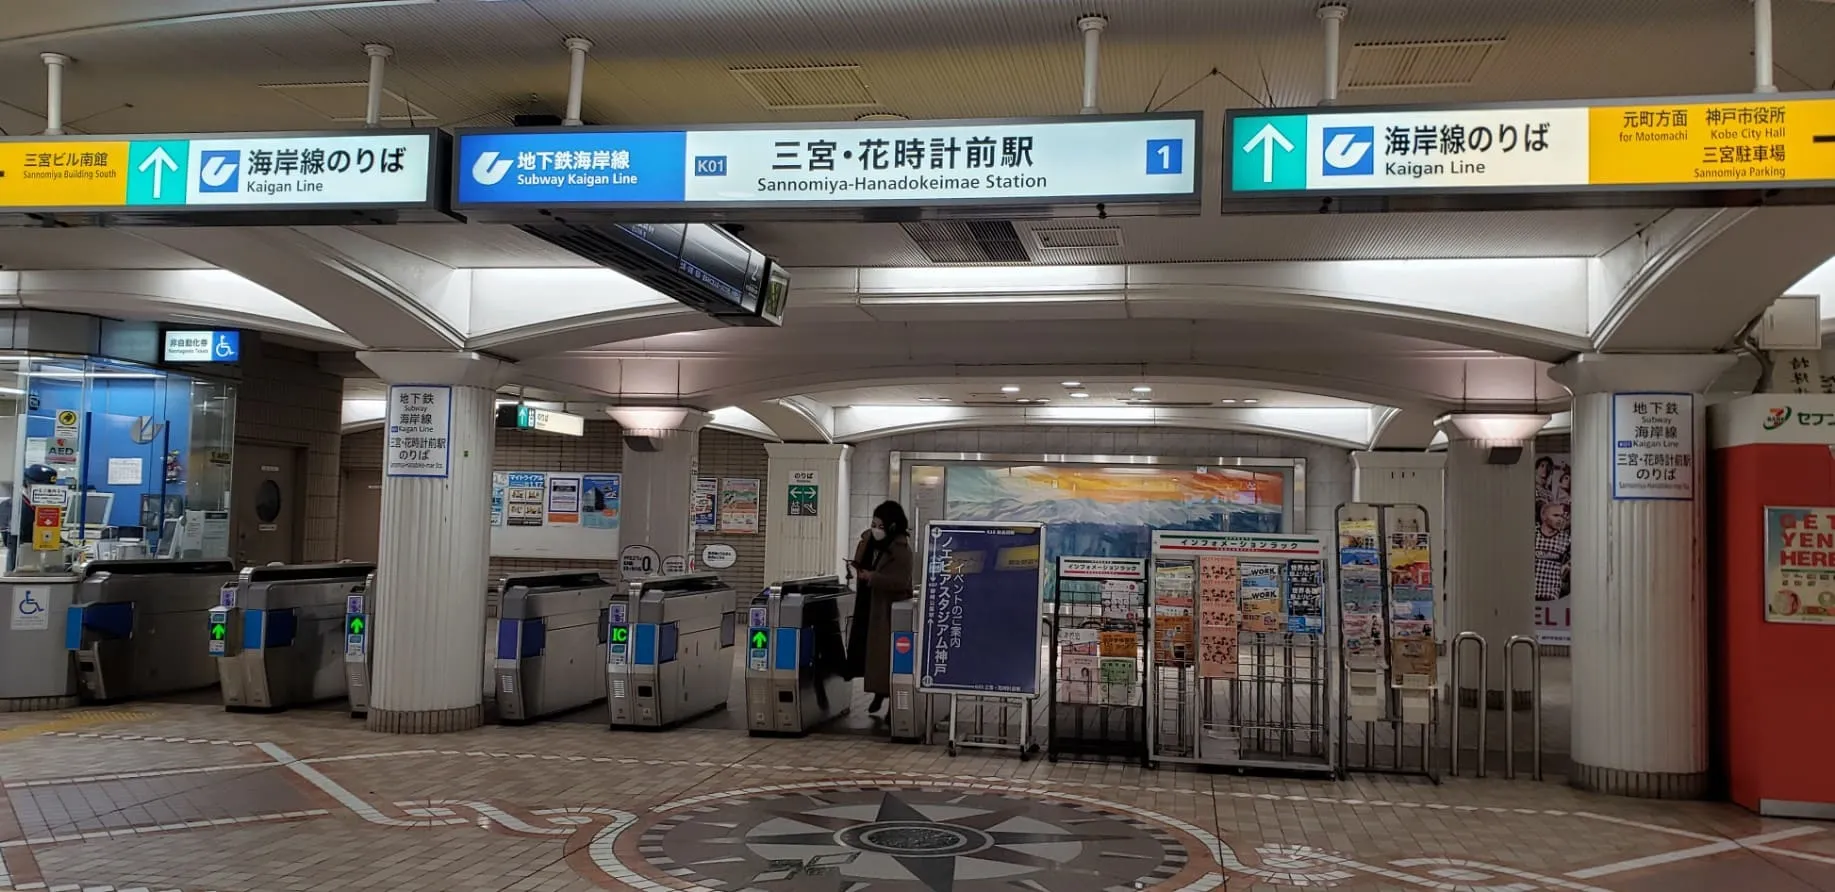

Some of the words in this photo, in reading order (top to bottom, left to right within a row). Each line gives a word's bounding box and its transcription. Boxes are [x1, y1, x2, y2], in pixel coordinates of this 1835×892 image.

[1623, 110, 1688, 128] 元町方面
[1706, 106, 1786, 126] 神戸市役所
[1385, 122, 1550, 156] 海岸線のりば
[1619, 132, 1634, 143] for
[1635, 130, 1688, 142] Motomachi
[1711, 129, 1738, 140] Kobe
[1741, 128, 1762, 141] City
[1765, 127, 1786, 138] Hall
[23, 152, 108, 168] 三宮ビル南館
[517, 150, 630, 171] 地下鉄海岸線
[772, 136, 1034, 171] 三宮・花時計前駅
[1156, 144, 1170, 170] 1
[1702, 144, 1786, 164] 三宮駐車場
[248, 147, 406, 176] 海岸線のりば
[698, 160, 724, 173] K01
[23, 169, 62, 180] Sannomiya
[64, 169, 93, 180] Building
[95, 168, 117, 178] South
[1385, 162, 1444, 178] Kaigan
[1451, 160, 1485, 175] Line
[1694, 167, 1747, 180] Sannomiya
[1749, 166, 1786, 179] Parking
[517, 174, 565, 187] Subway
[568, 173, 609, 187] Kaigan
[613, 172, 638, 185] Line
[757, 174, 980, 193] Sannomiya-Hanadokeimae
[986, 173, 1047, 190] Station
[247, 181, 292, 195] Kaigan
[296, 180, 323, 193] Line
[400, 393, 434, 404] 地下鉄
[1633, 401, 1679, 415] 地下鉄
[400, 413, 432, 425] 海岸線
[1642, 416, 1672, 425] Subway
[1635, 426, 1678, 439] 海岸線
[48, 447, 74, 456] AED
[1633, 440, 1661, 449] Kaigan
[1663, 440, 1679, 449] Line
[399, 449, 430, 460] のりば
[1636, 468, 1676, 481] のりば
[1181, 541, 1298, 550] インフォメーションラック
[1782, 532, 1833, 549] YEN
[933, 536, 953, 677] ノエビアスタジアム神戸
[950, 563, 965, 648] イベントのご案内
[612, 628, 628, 642] IC
